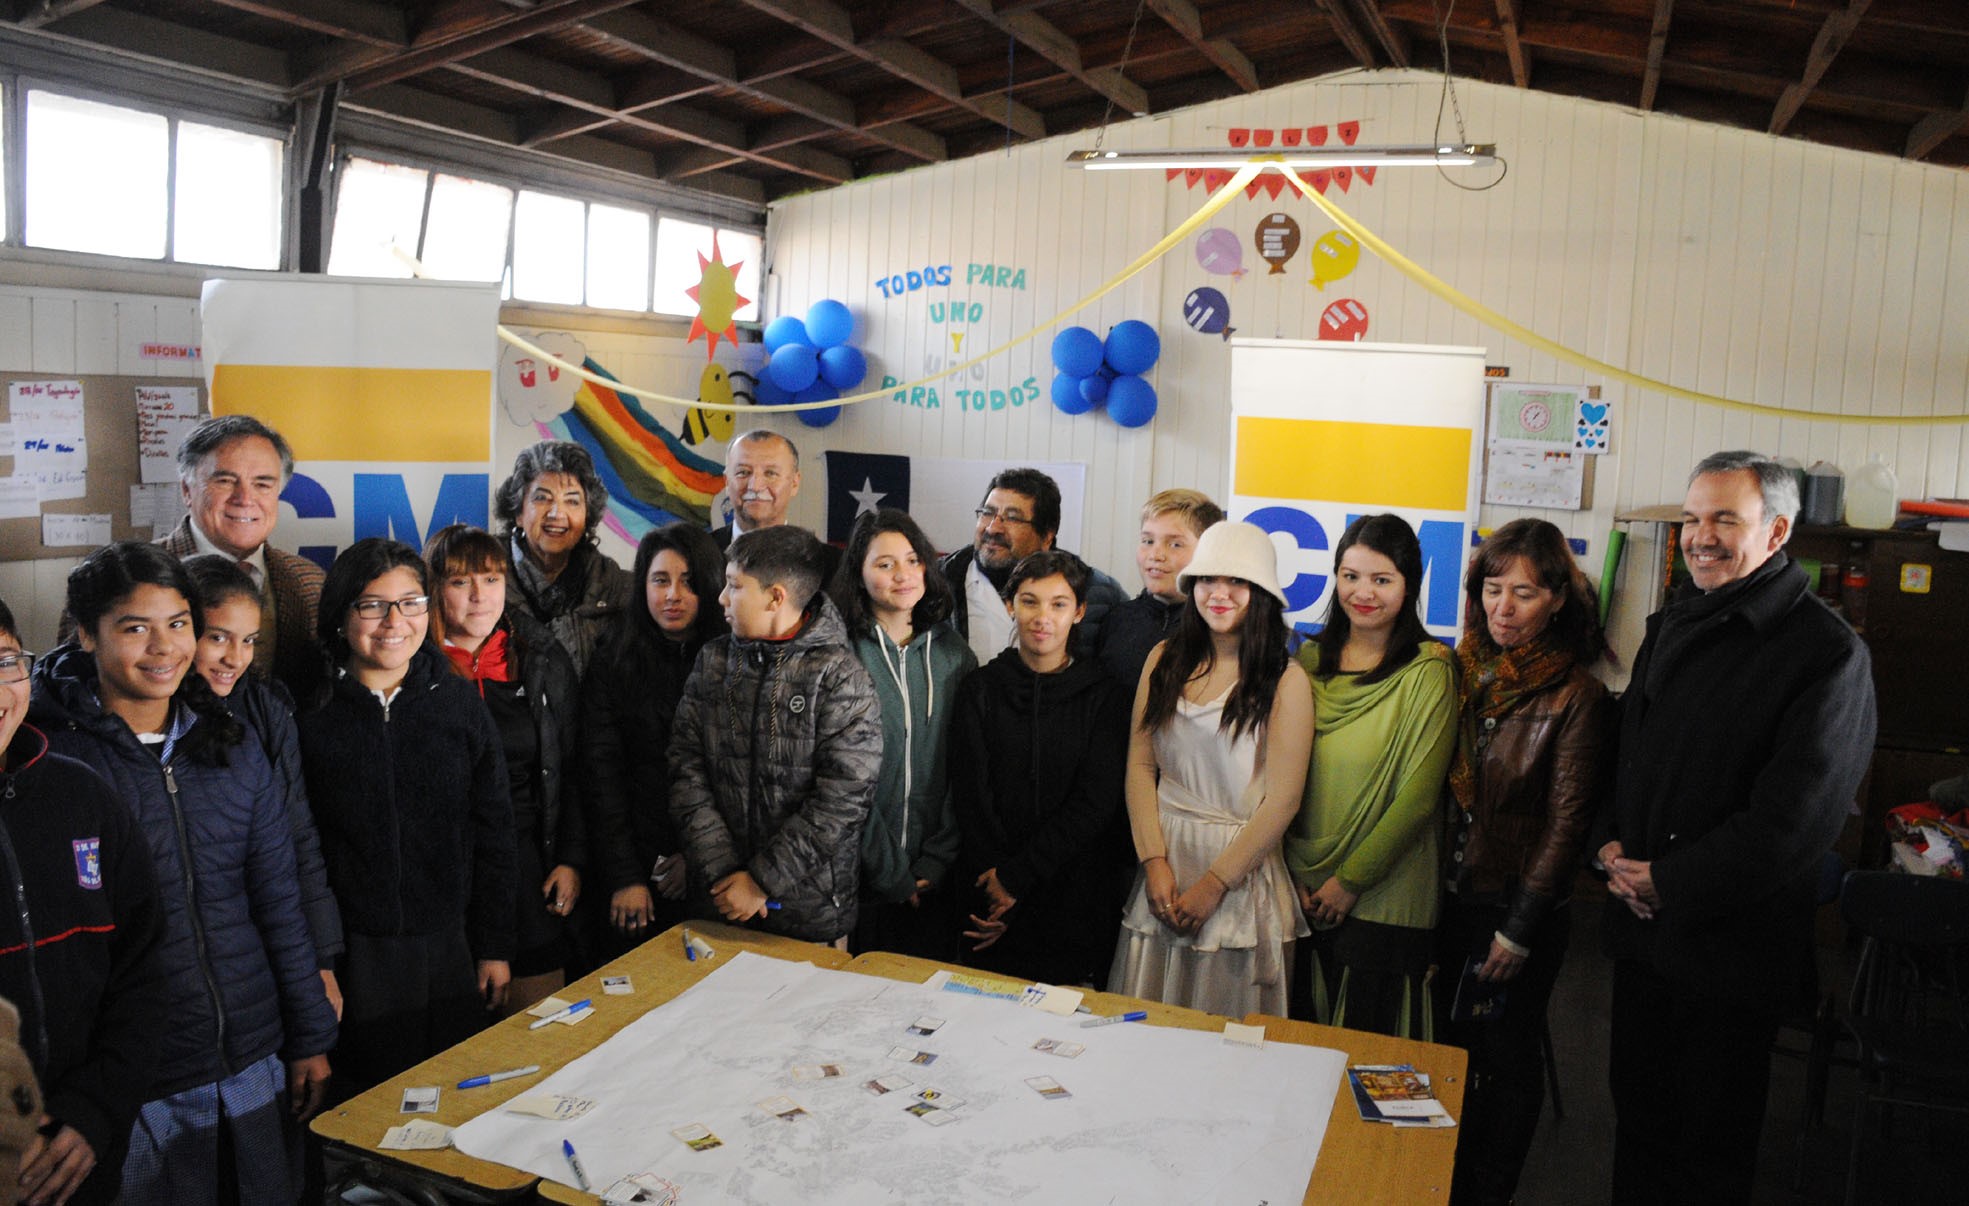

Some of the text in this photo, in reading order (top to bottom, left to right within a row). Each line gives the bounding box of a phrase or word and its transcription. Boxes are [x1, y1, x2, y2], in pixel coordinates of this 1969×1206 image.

[875, 263, 1026, 299] TODOS PARA
[930, 301, 983, 324] UNO
[951, 332, 965, 353] Y
[881, 375, 1041, 412] PARA TODOS
